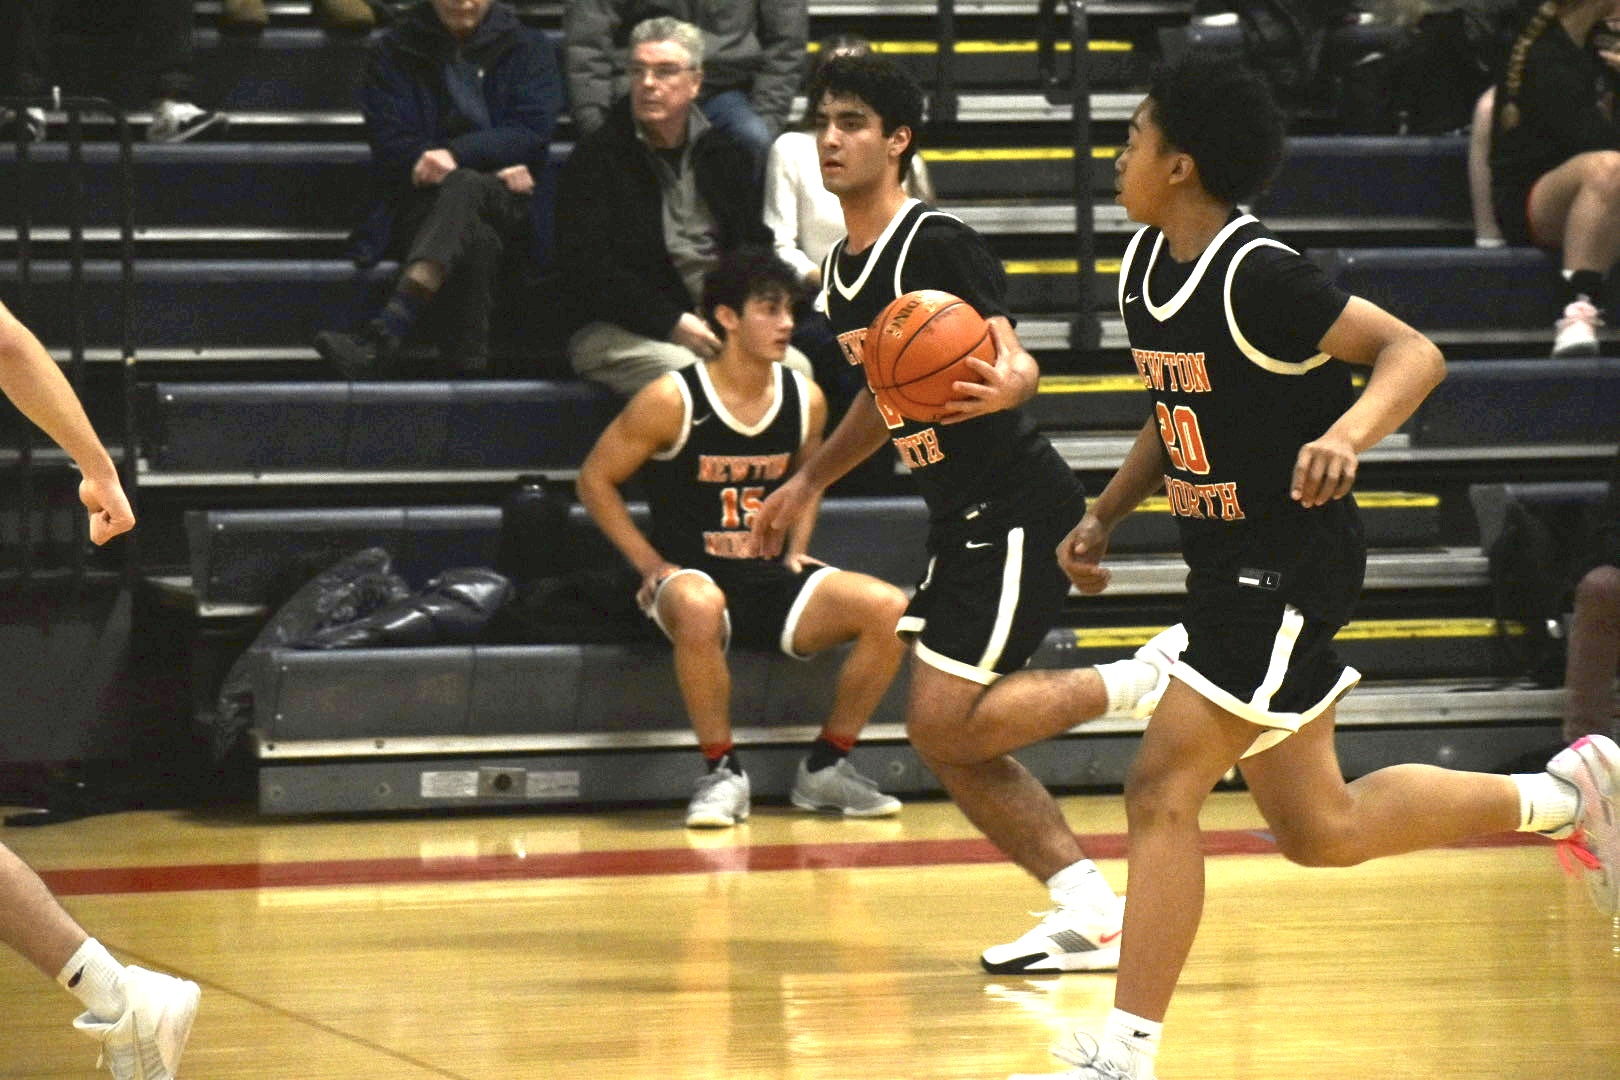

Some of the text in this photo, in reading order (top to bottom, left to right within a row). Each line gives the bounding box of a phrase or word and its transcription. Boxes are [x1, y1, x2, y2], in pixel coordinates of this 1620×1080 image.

[1131, 348, 1212, 393] EWTON
[1156, 401, 1211, 475] 20
[720, 486, 765, 529] 15
